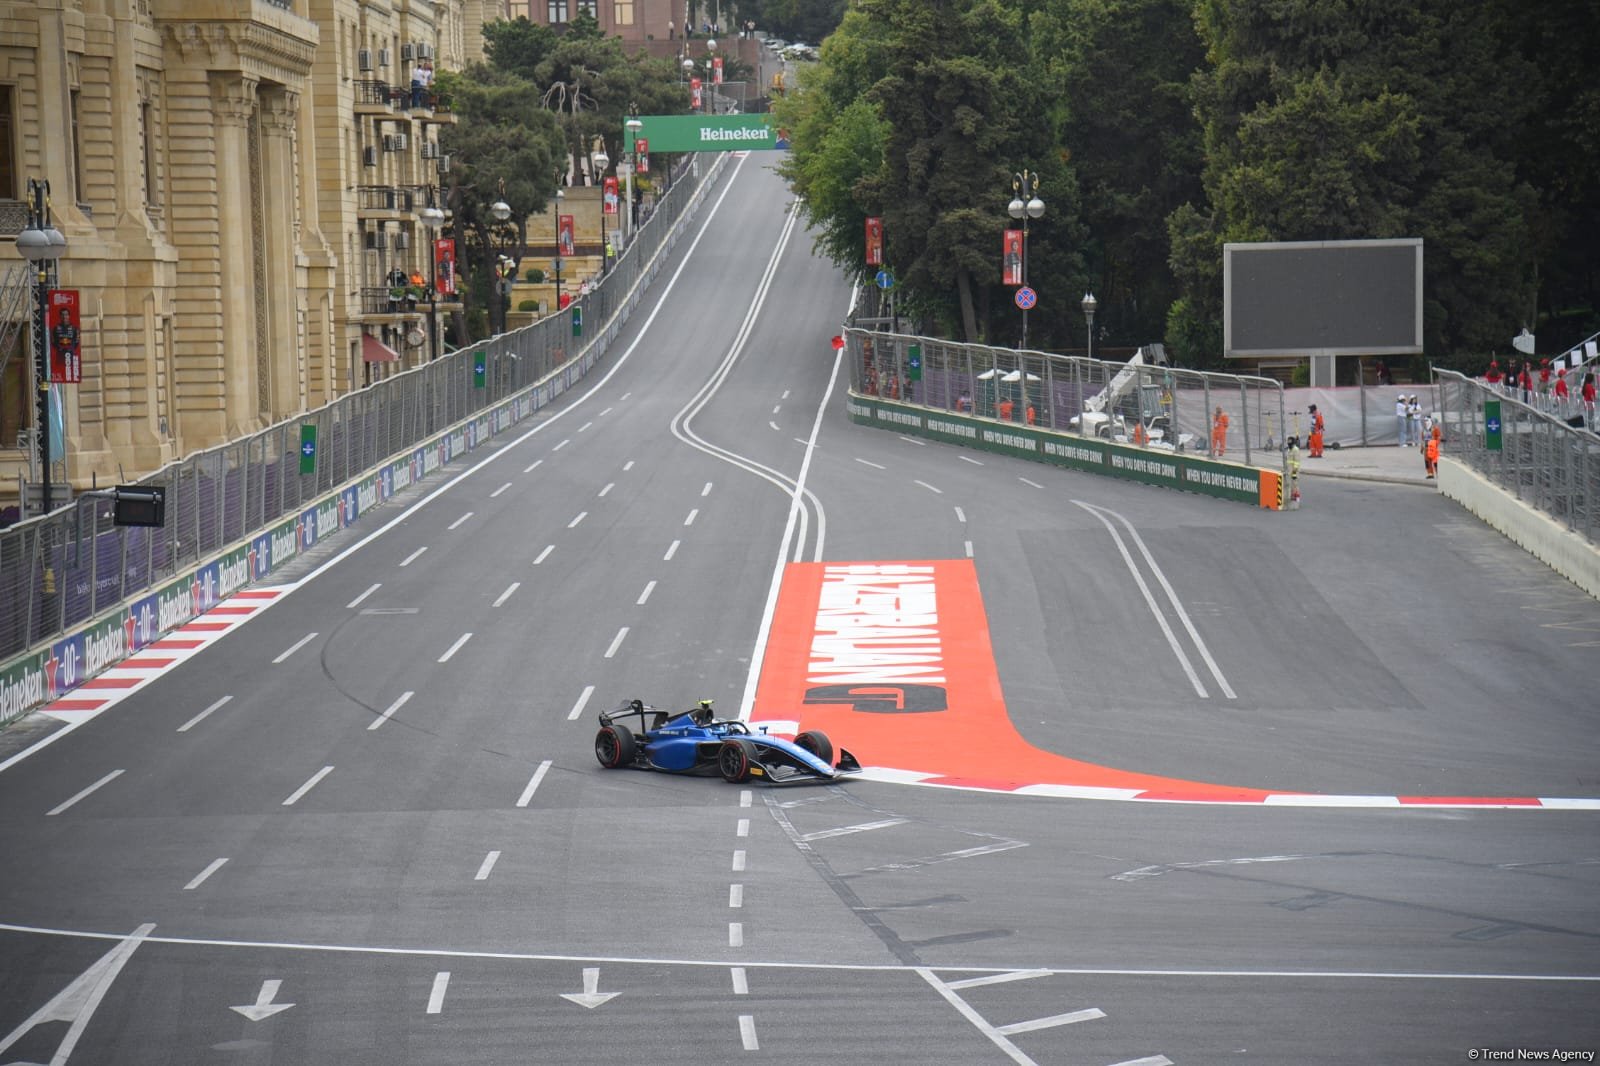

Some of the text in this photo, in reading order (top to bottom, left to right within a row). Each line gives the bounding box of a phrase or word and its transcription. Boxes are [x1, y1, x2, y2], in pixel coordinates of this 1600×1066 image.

[700, 127, 769, 140] Heineken
[1112, 454, 1176, 478] WHEN YOU DRIVE NEVER DRINK
[1186, 468, 1258, 493] WHEN YOU DRIVE NEVER DRINK
[219, 554, 248, 597] Heineken
[158, 587, 190, 632] Heineken
[85, 624, 123, 676] Heineken
